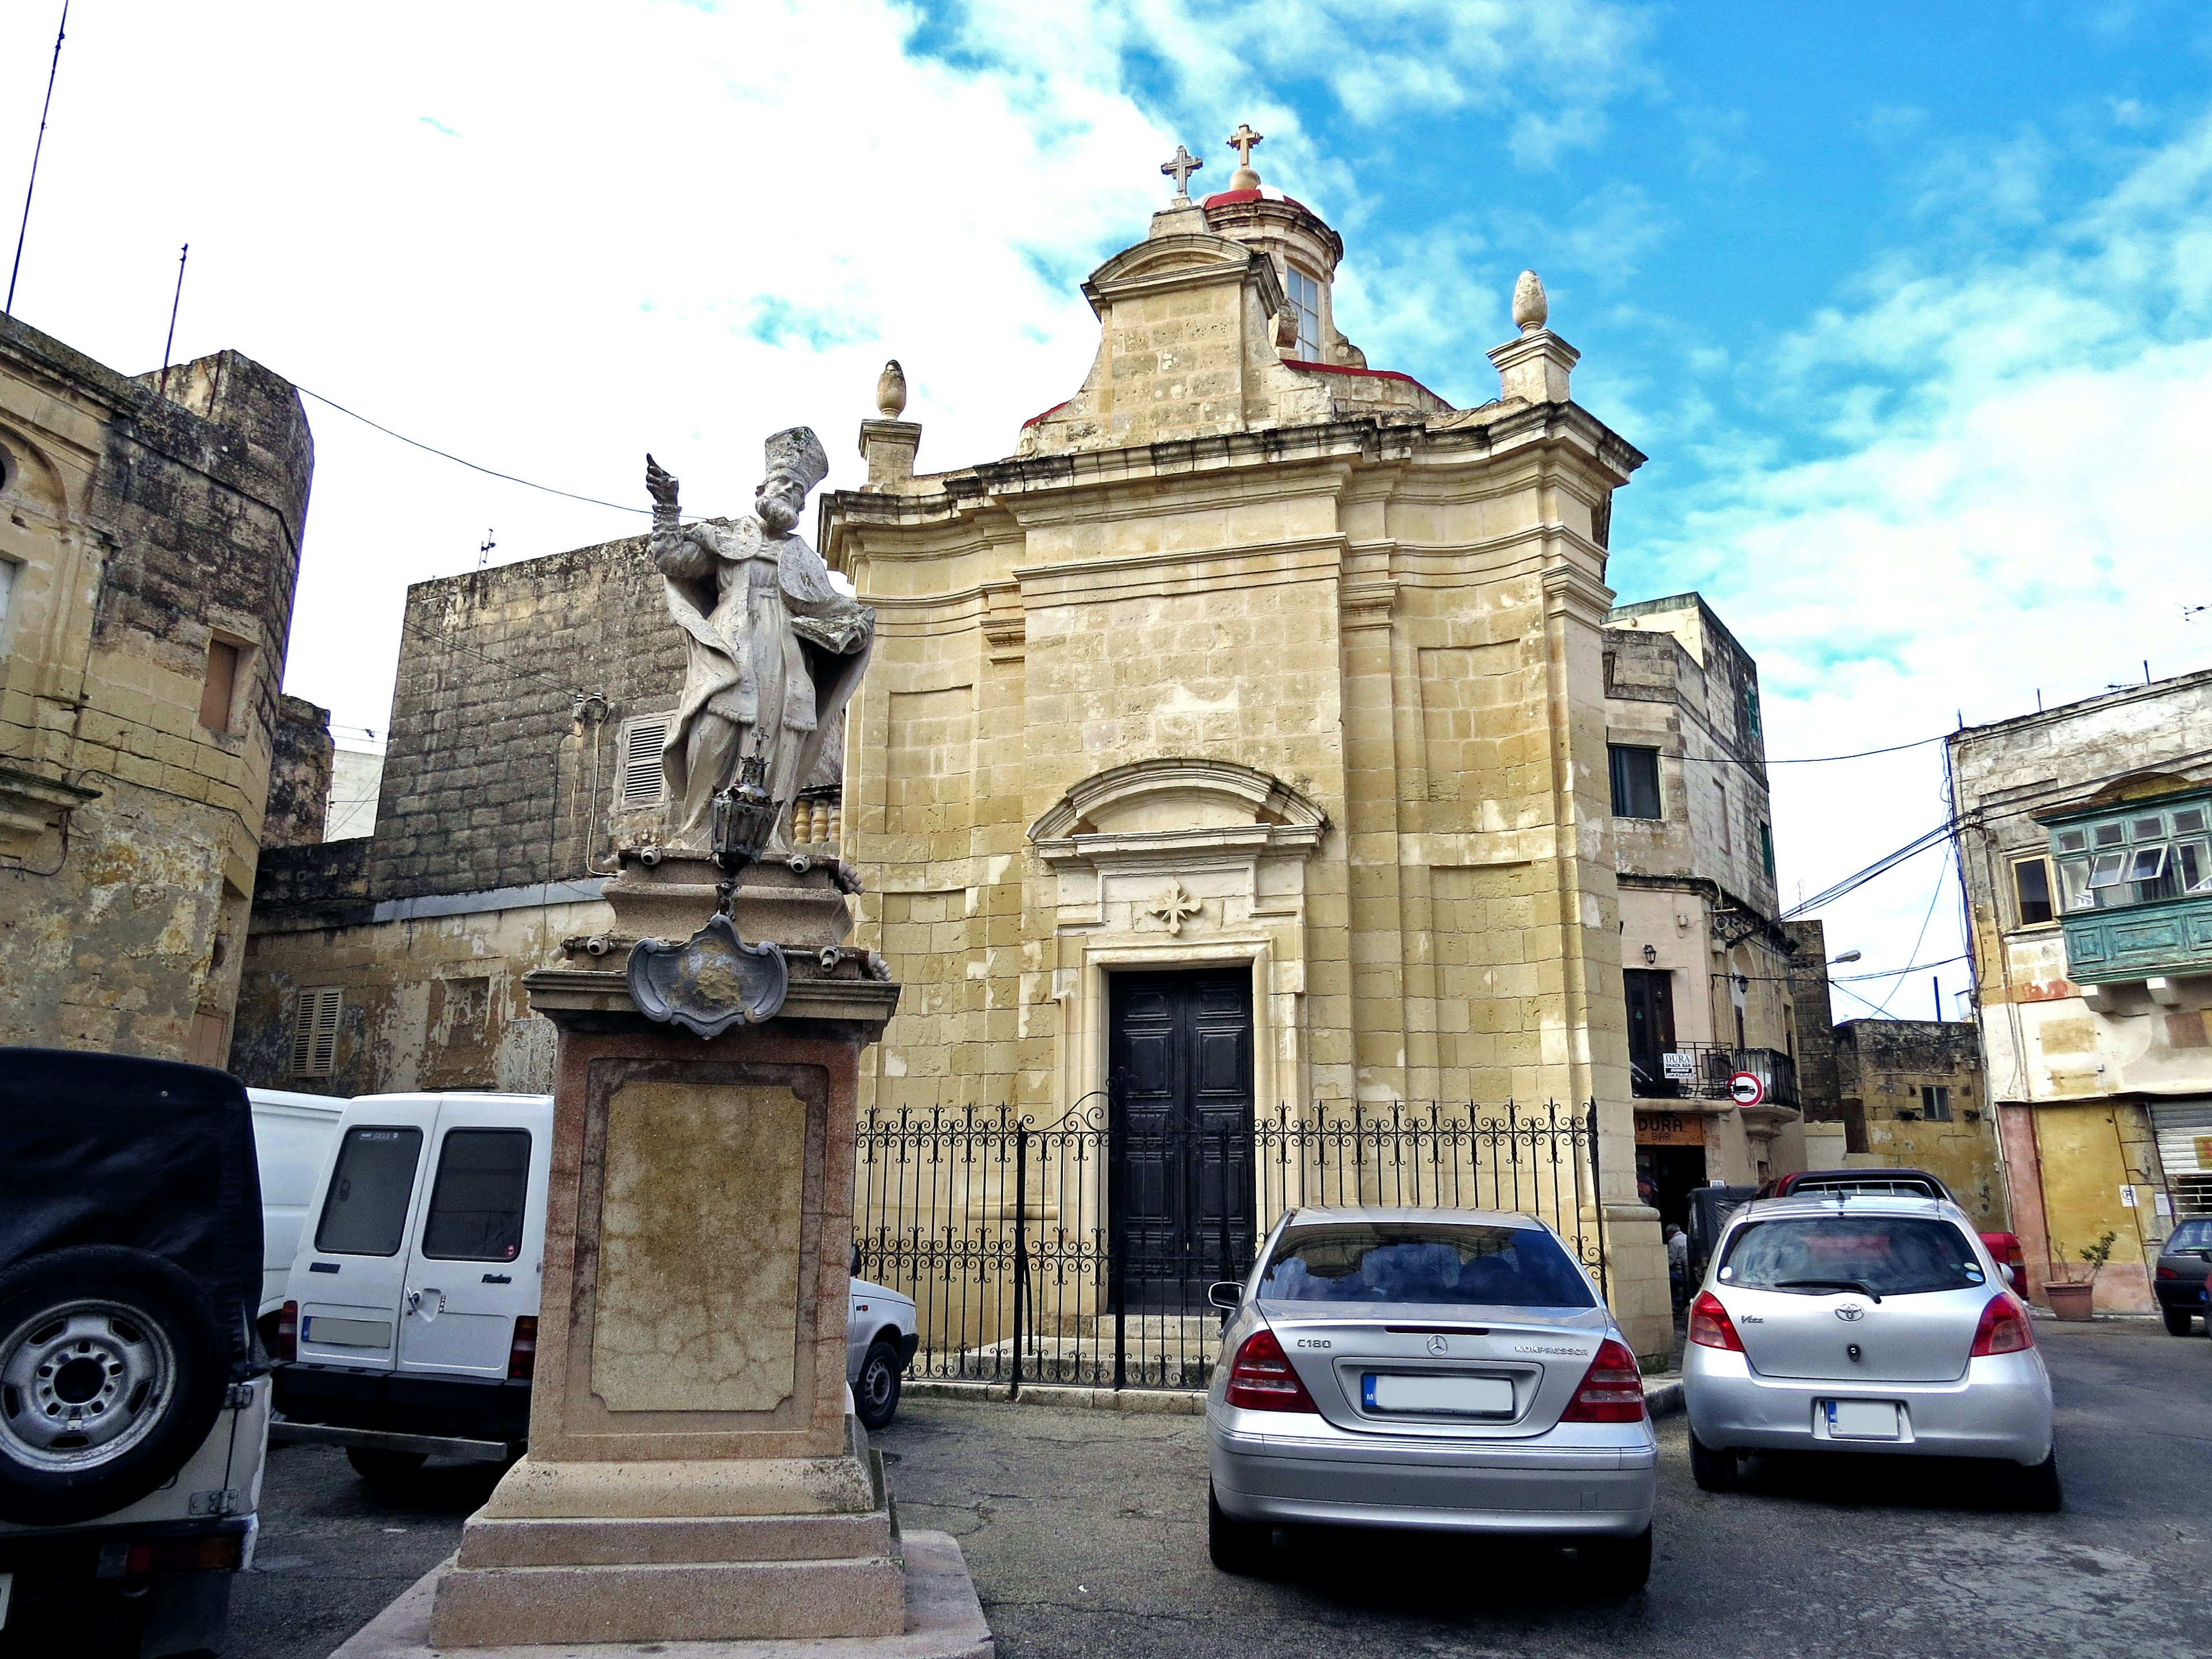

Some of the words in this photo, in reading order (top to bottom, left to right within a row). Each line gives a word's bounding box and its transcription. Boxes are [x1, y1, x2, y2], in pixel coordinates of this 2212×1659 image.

[1665, 1055, 1691, 1063] DURA
[1638, 1118, 1683, 1132] DURA
[1652, 1132, 1671, 1141] BAR
[1514, 1345, 1589, 1356] KOMPRESSOR
